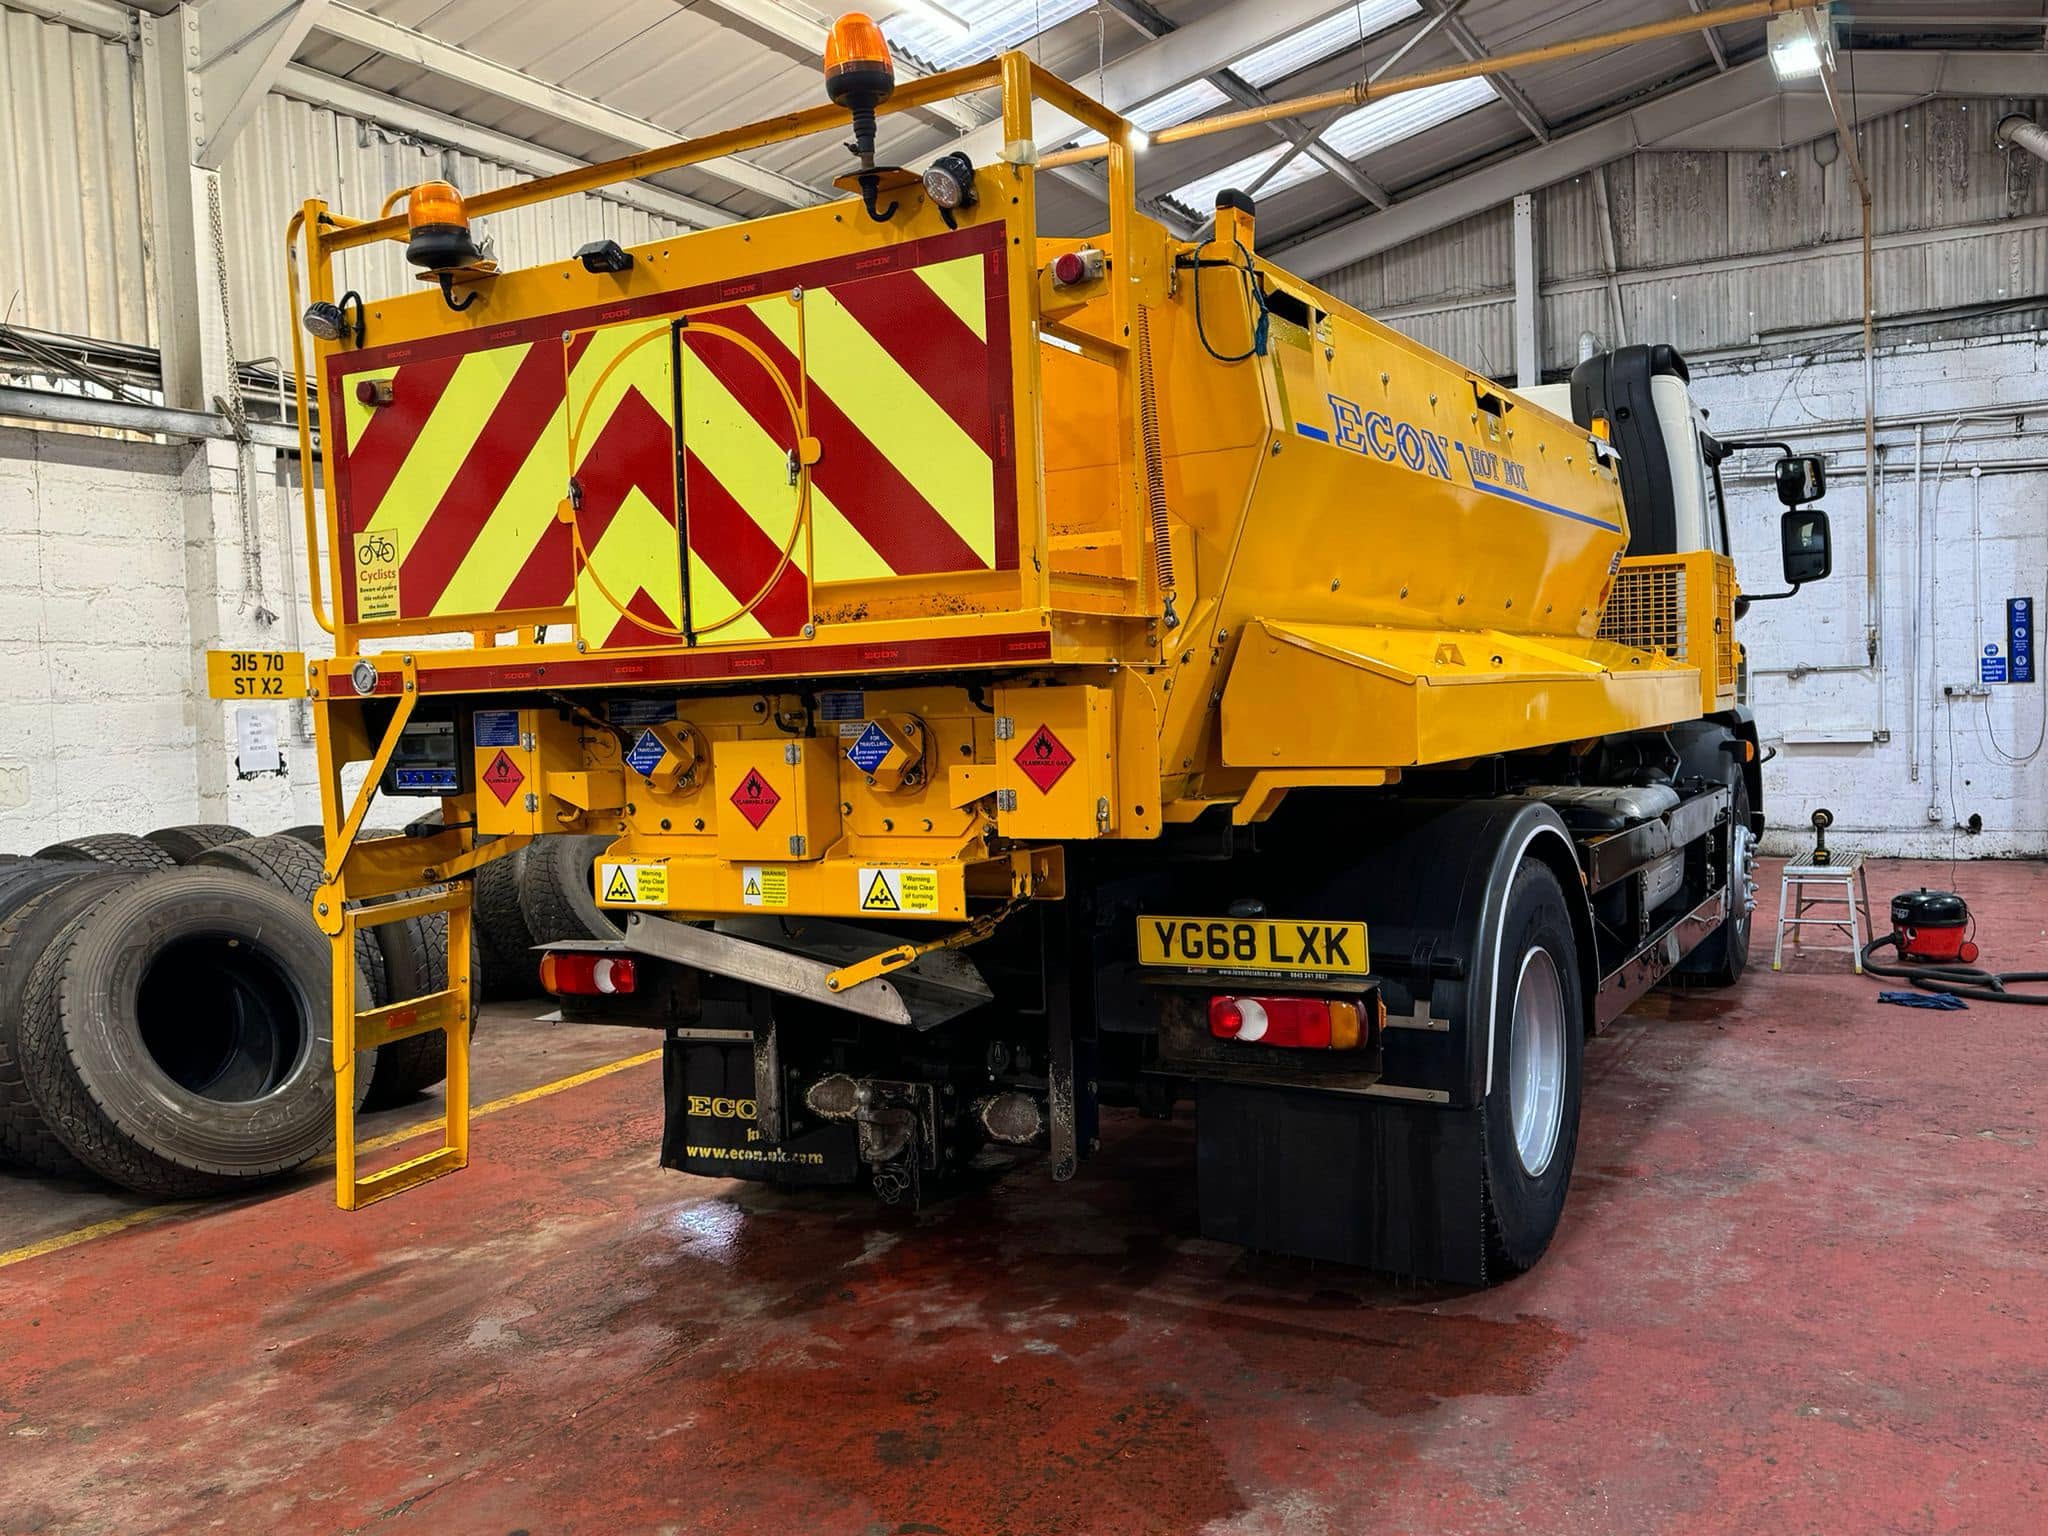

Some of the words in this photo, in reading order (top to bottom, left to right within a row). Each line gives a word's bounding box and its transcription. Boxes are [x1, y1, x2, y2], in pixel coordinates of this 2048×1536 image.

[1326, 393, 1452, 480] ECON
[1469, 447, 1501, 481] HOT
[1503, 457, 1529, 491] BOX
[360, 569, 397, 584] Cyclists
[1008, 641, 1047, 651] ECON
[231, 654, 257, 671] 315
[263, 654, 284, 671] 70
[864, 650, 899, 660] ECON
[234, 677, 256, 695] ST
[261, 677, 283, 695] X2
[641, 870, 662, 878] Warning
[906, 875, 931, 883] Warning
[912, 893, 934, 901] turning
[1155, 921, 1257, 961] YG68
[1268, 925, 1350, 966] LXK
[688, 1096, 757, 1119] ECO
